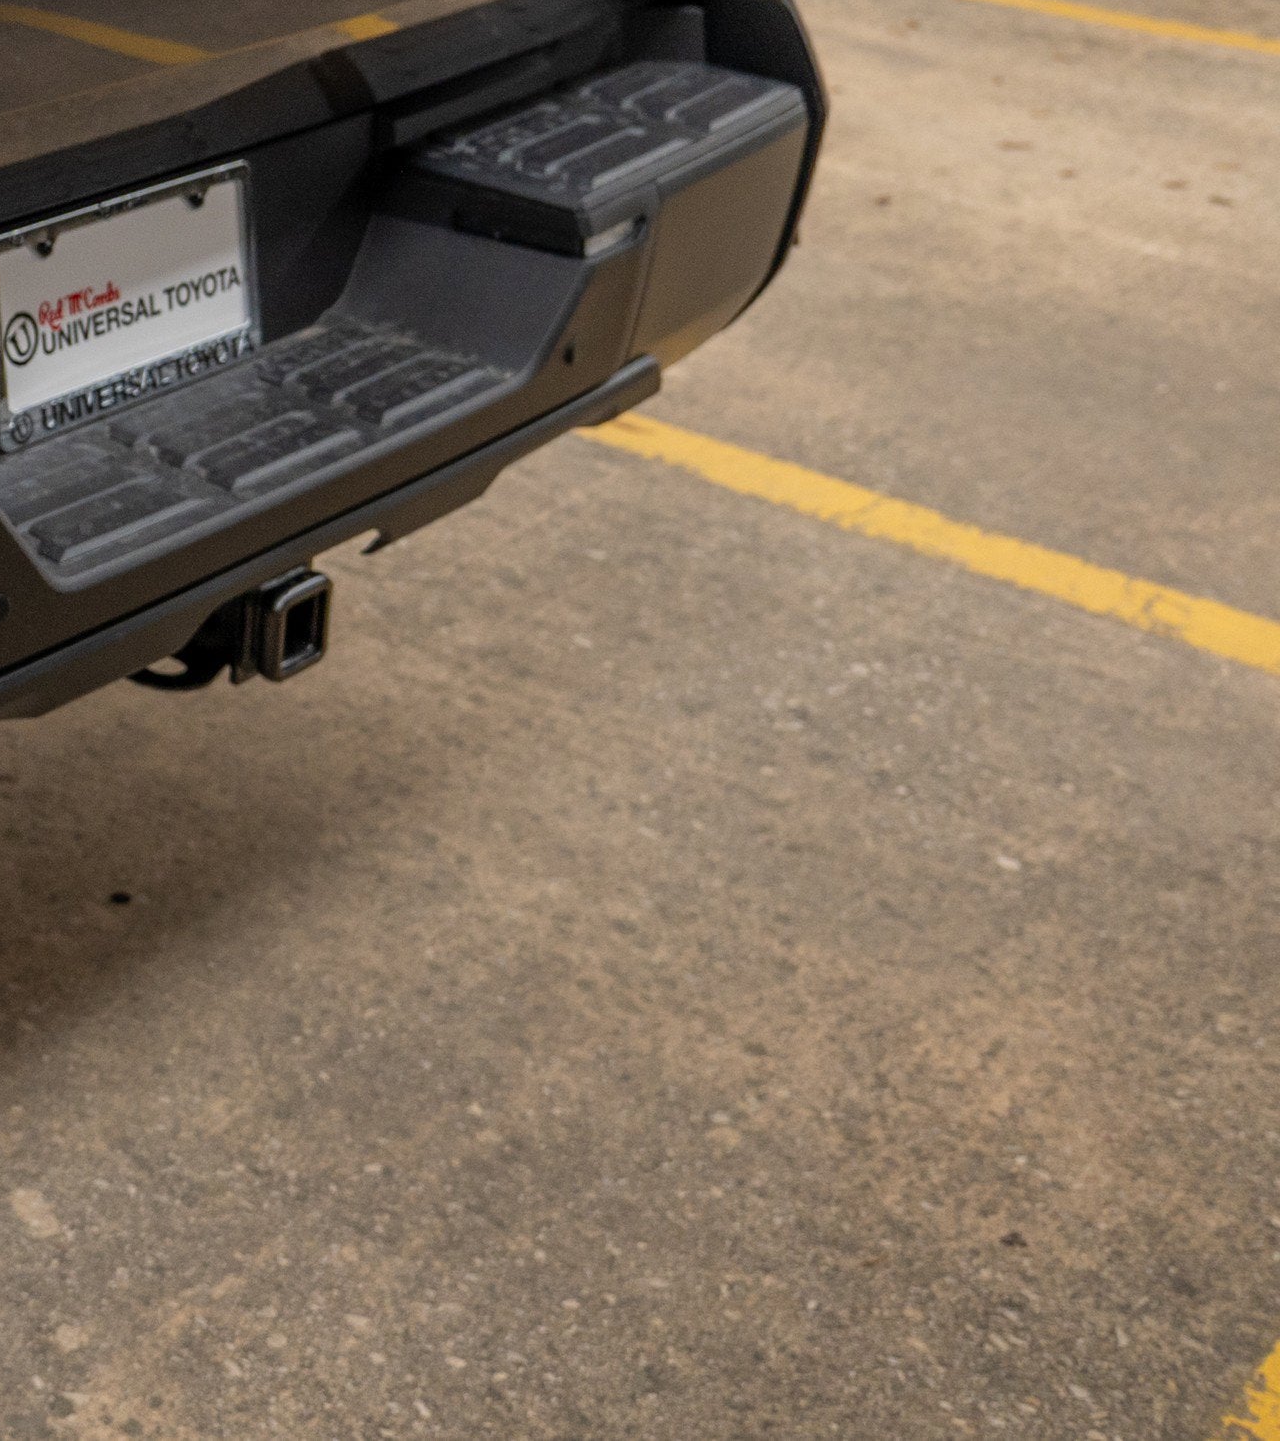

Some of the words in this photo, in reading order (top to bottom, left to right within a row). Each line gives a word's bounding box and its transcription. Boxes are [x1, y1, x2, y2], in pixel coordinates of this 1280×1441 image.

[38, 298, 64, 332] Red
[42, 294, 161, 355] UNIVERSAL
[163, 266, 241, 311] TOYOTA
[42, 366, 172, 431] UNIVERSAL
[171, 328, 256, 380] TOYOTA
